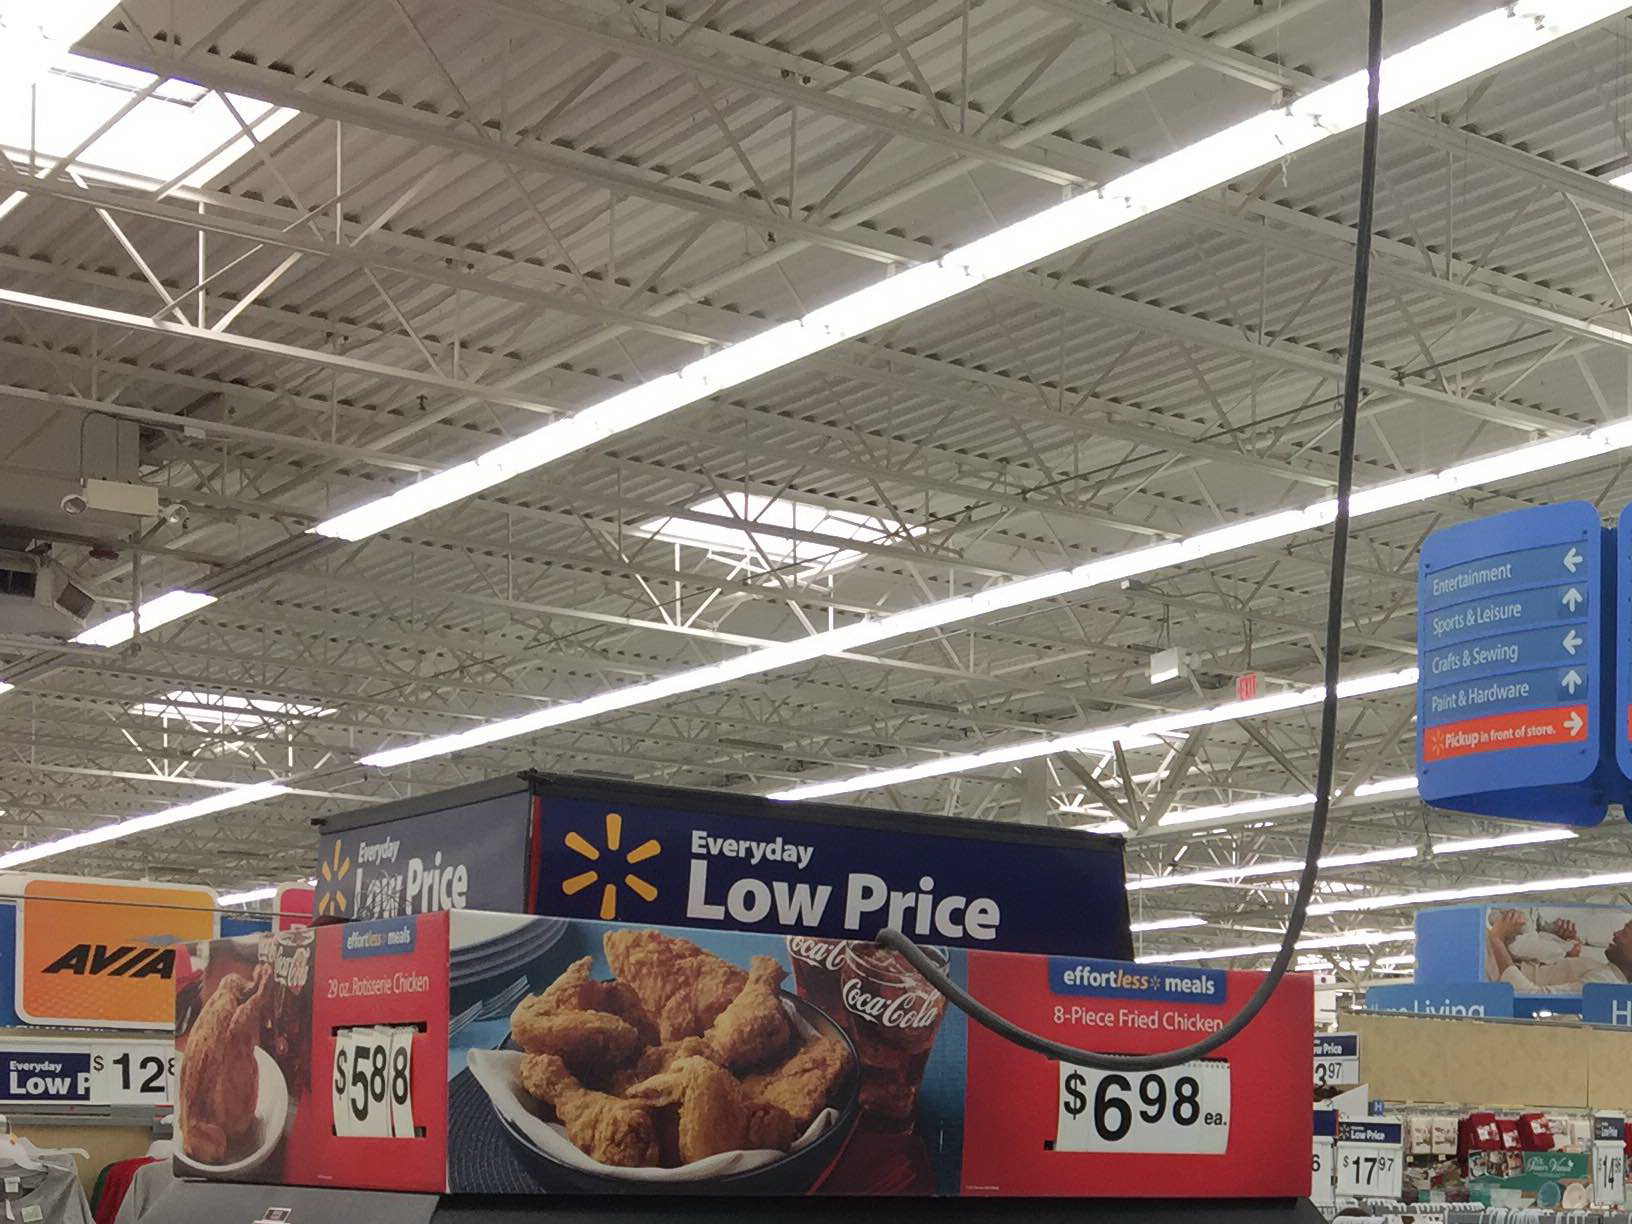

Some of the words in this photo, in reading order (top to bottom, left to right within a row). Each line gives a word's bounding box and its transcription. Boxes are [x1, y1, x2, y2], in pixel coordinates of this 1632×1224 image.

[1433, 563, 1512, 596] Entertainment
[1433, 613, 1463, 635] Sports
[1466, 611, 1476, 627] &
[1477, 602, 1521, 626] Leisure
[1432, 654, 1460, 675] Crafts
[1463, 653, 1471, 668] &
[1473, 643, 1518, 667] Sewing
[1431, 691, 1455, 712] Paint
[1457, 690, 1466, 706] &
[1468, 682, 1529, 703] Hardware
[358, 836, 400, 866] Everyday
[691, 830, 814, 869] Everyday
[686, 859, 832, 927] Low
[844, 873, 1000, 941] Price
[387, 926, 410, 945] meals
[41, 944, 176, 979] AVIA
[328, 979, 337, 998] 29
[352, 975, 392, 996] Rotisserie
[393, 972, 429, 994] Chicken
[1063, 967, 1149, 992] effortless
[1164, 973, 1215, 996] meals
[1053, 1006, 1113, 1027] 8-Piece
[1118, 1008, 1159, 1029] Fried
[1161, 1010, 1223, 1034] Chicken
[1323, 1043, 1342, 1055] Price
[9, 1060, 62, 1074] Everyday
[9, 1073, 70, 1096] Low
[1204, 1112, 1228, 1127] ea.
[1350, 1130, 1366, 1140] Low
[1367, 1131, 1385, 1141] Price
